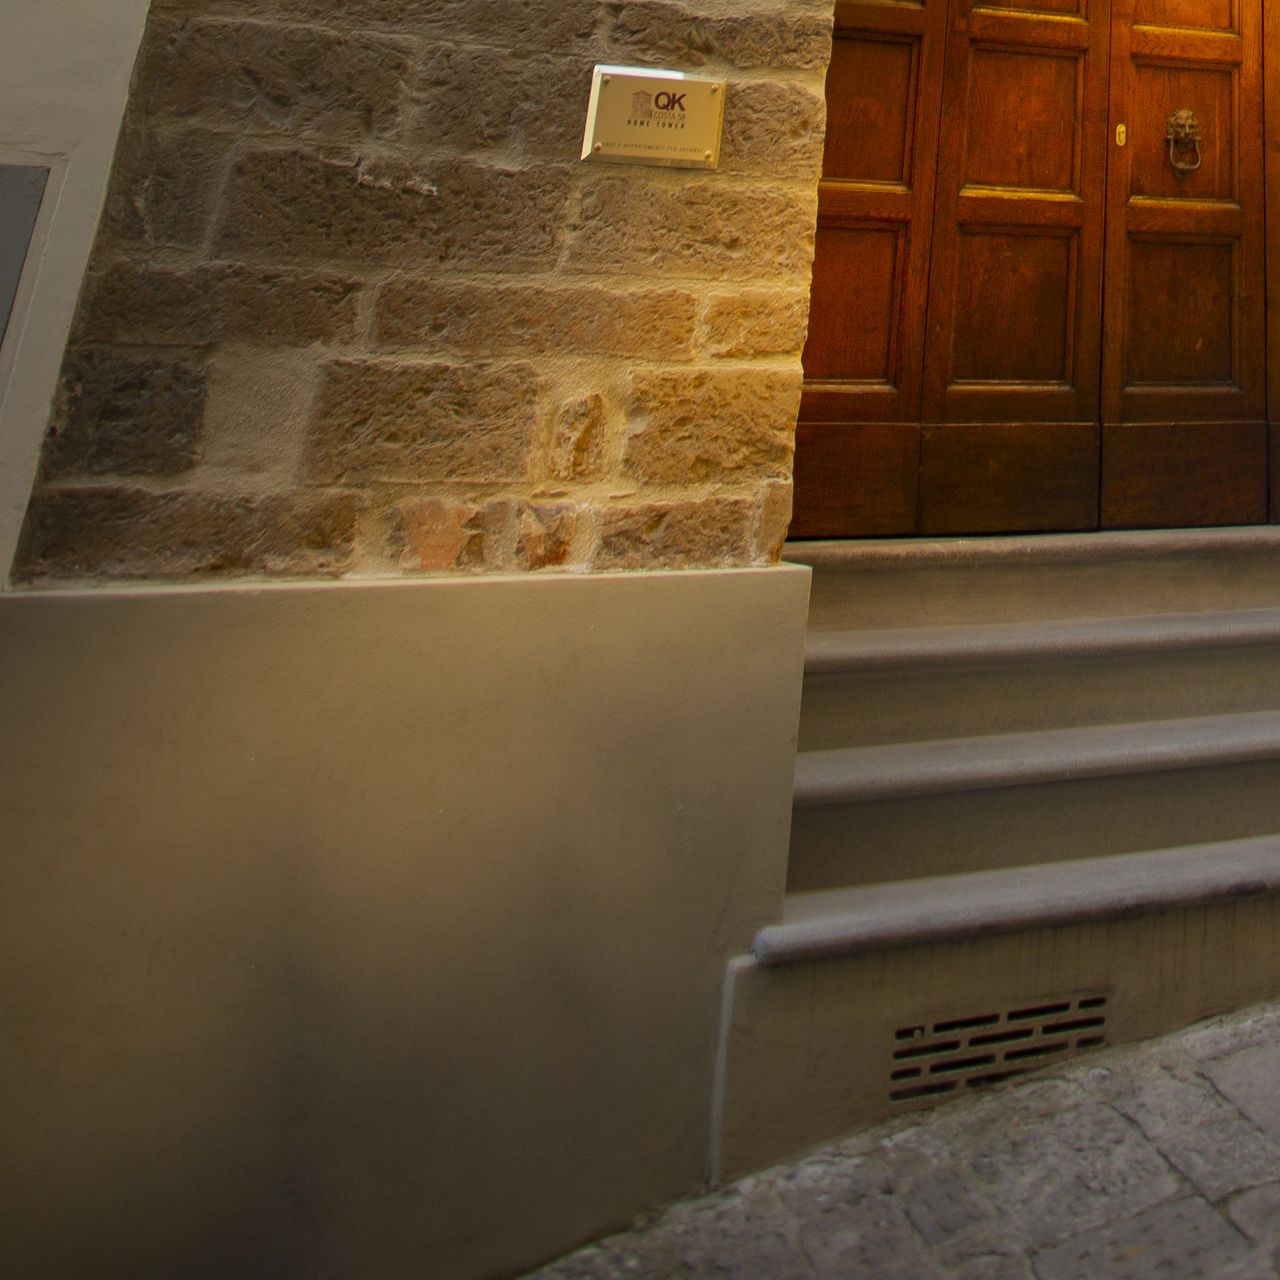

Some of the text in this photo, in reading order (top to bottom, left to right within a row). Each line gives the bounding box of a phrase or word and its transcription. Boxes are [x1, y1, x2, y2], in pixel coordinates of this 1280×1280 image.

[654, 111, 676, 120] COSTA
[627, 119, 685, 129] HOME TOWER
